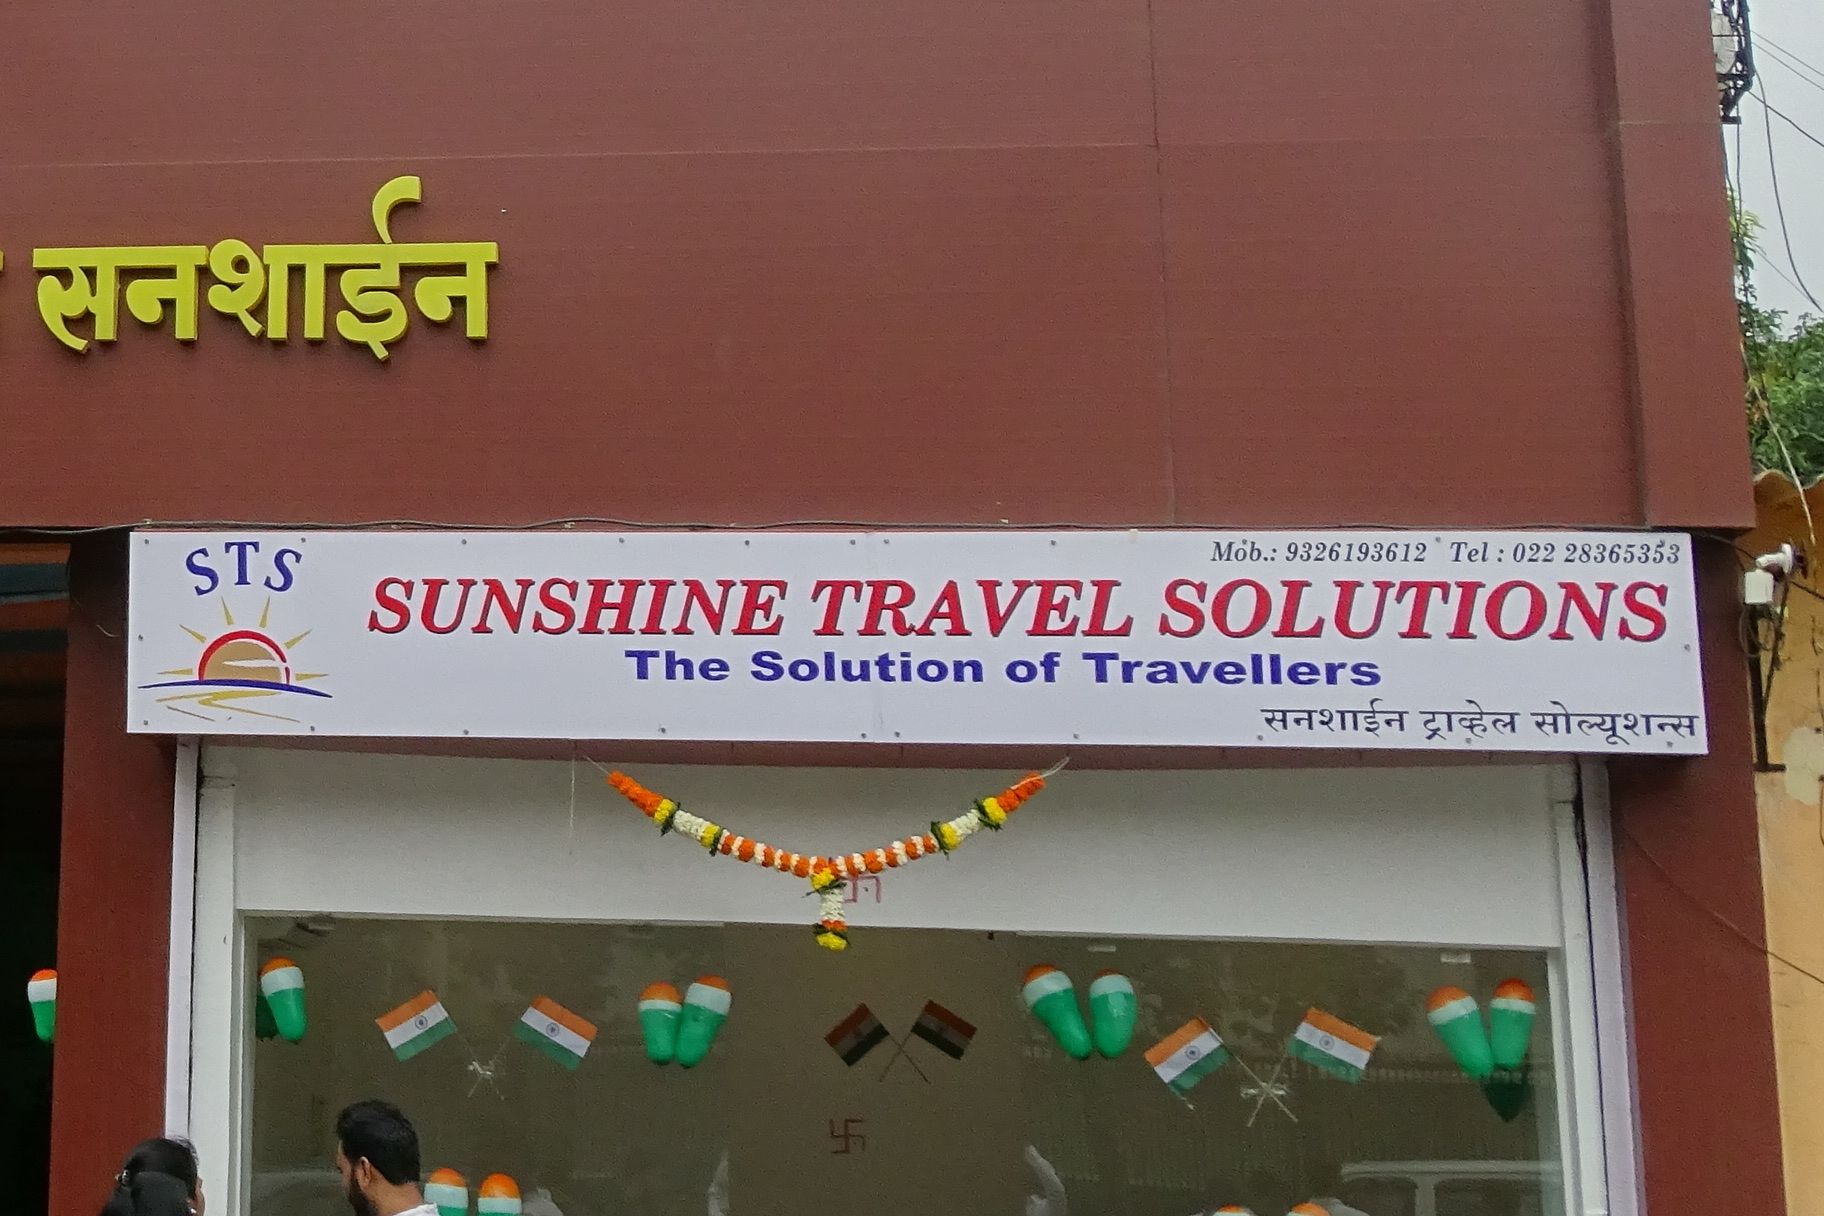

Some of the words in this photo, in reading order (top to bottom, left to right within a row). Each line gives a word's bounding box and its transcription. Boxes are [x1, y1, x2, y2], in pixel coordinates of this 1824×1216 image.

[31, 174, 500, 360] सनशाईन
[184, 541, 302, 597] STS
[1285, 541, 1427, 563] 9326193612
[1512, 542, 1556, 564] 022
[1563, 542, 1681, 564] 28365353
[367, 577, 788, 637] SUNSHINE
[810, 579, 1134, 638] TRAVEL
[1157, 578, 1670, 642] SOLUTIONS
[624, 650, 731, 682] The
[750, 650, 984, 683] Solution
[1005, 652, 1061, 684] of
[1082, 652, 1382, 687] Travellers
[1259, 697, 1410, 738] सनशाईन
